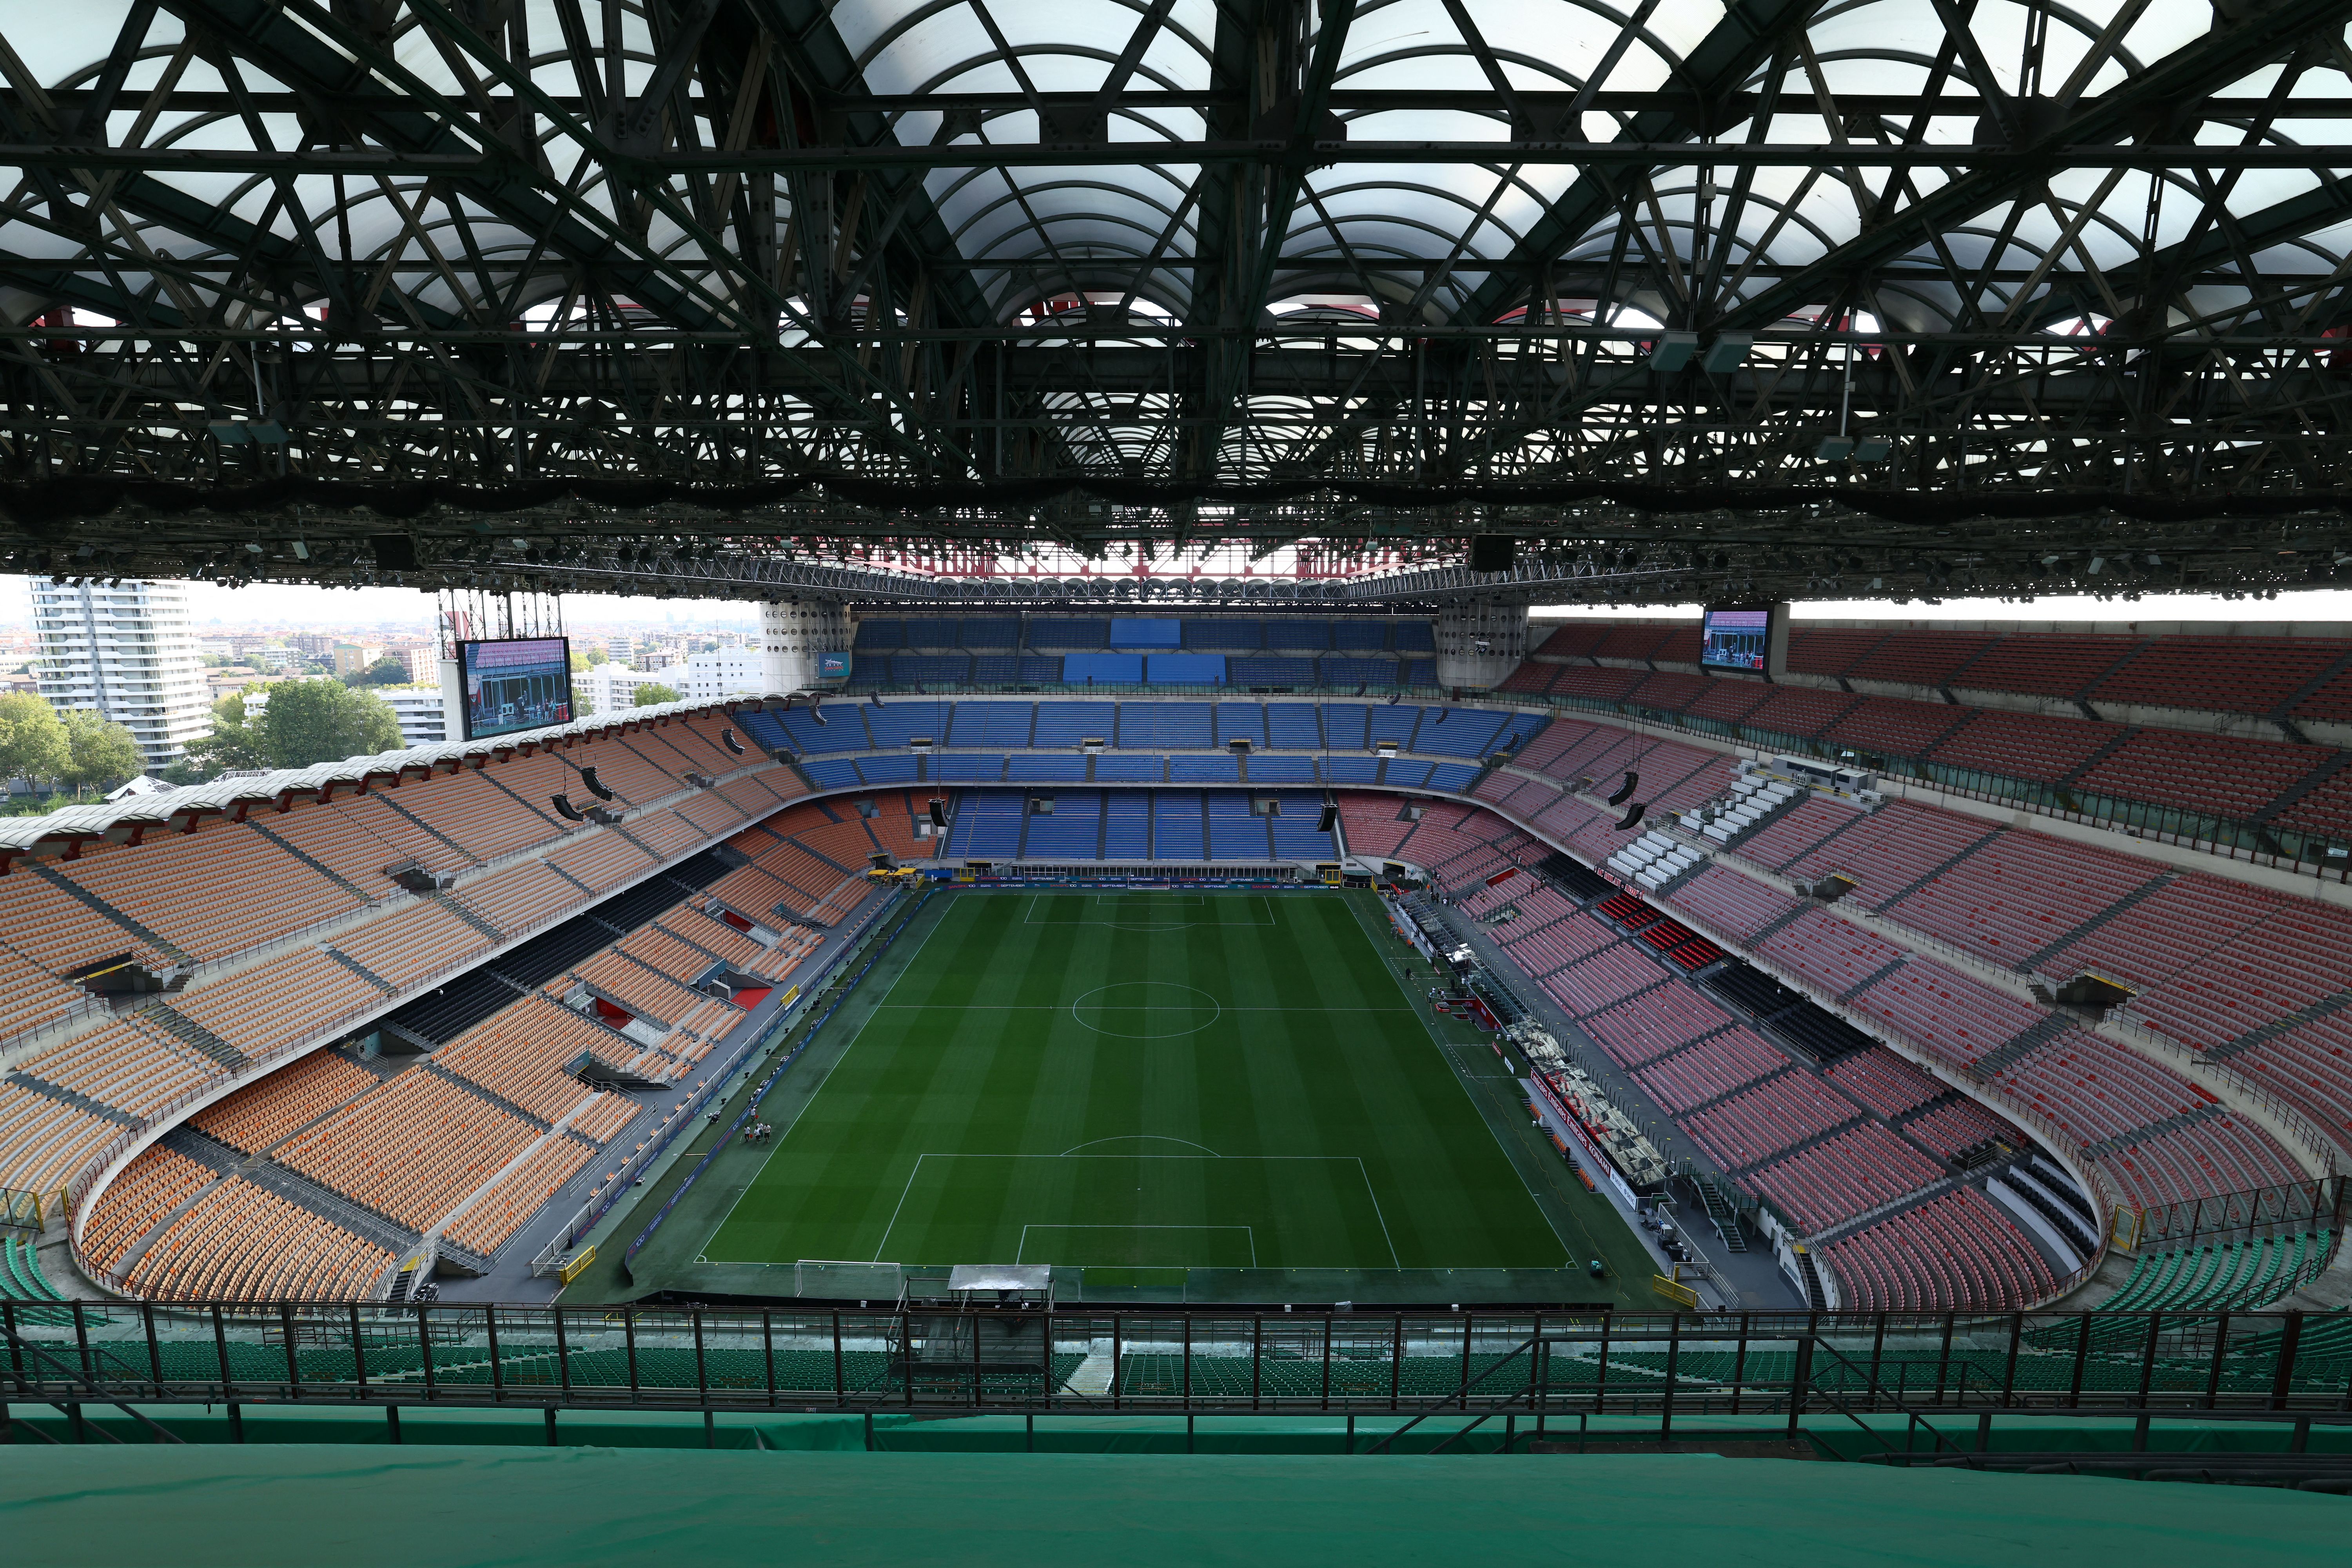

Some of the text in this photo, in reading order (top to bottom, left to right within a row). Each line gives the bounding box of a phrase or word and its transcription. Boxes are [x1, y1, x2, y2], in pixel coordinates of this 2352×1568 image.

[1597, 868, 1604, 878] AC
[1604, 871, 1622, 888] MILAN
[1492, 1042, 1501, 1056] Emirates
[717, 1070, 734, 1090] SEPTEMBER
[756, 1080, 773, 1103] SEPTEMBER
[678, 1122, 687, 1131] SAN
[1531, 1069, 1610, 1174] Emirates Emirates Emirates KONAMI
[634, 1151, 658, 1178] SEPTEMBER
[671, 1174, 695, 1205] SEPTEMBER
[1627, 1192, 1635, 1205] MSC
[579, 1202, 610, 1237] SAN SIRO 100
[636, 1235, 645, 1247] 100
